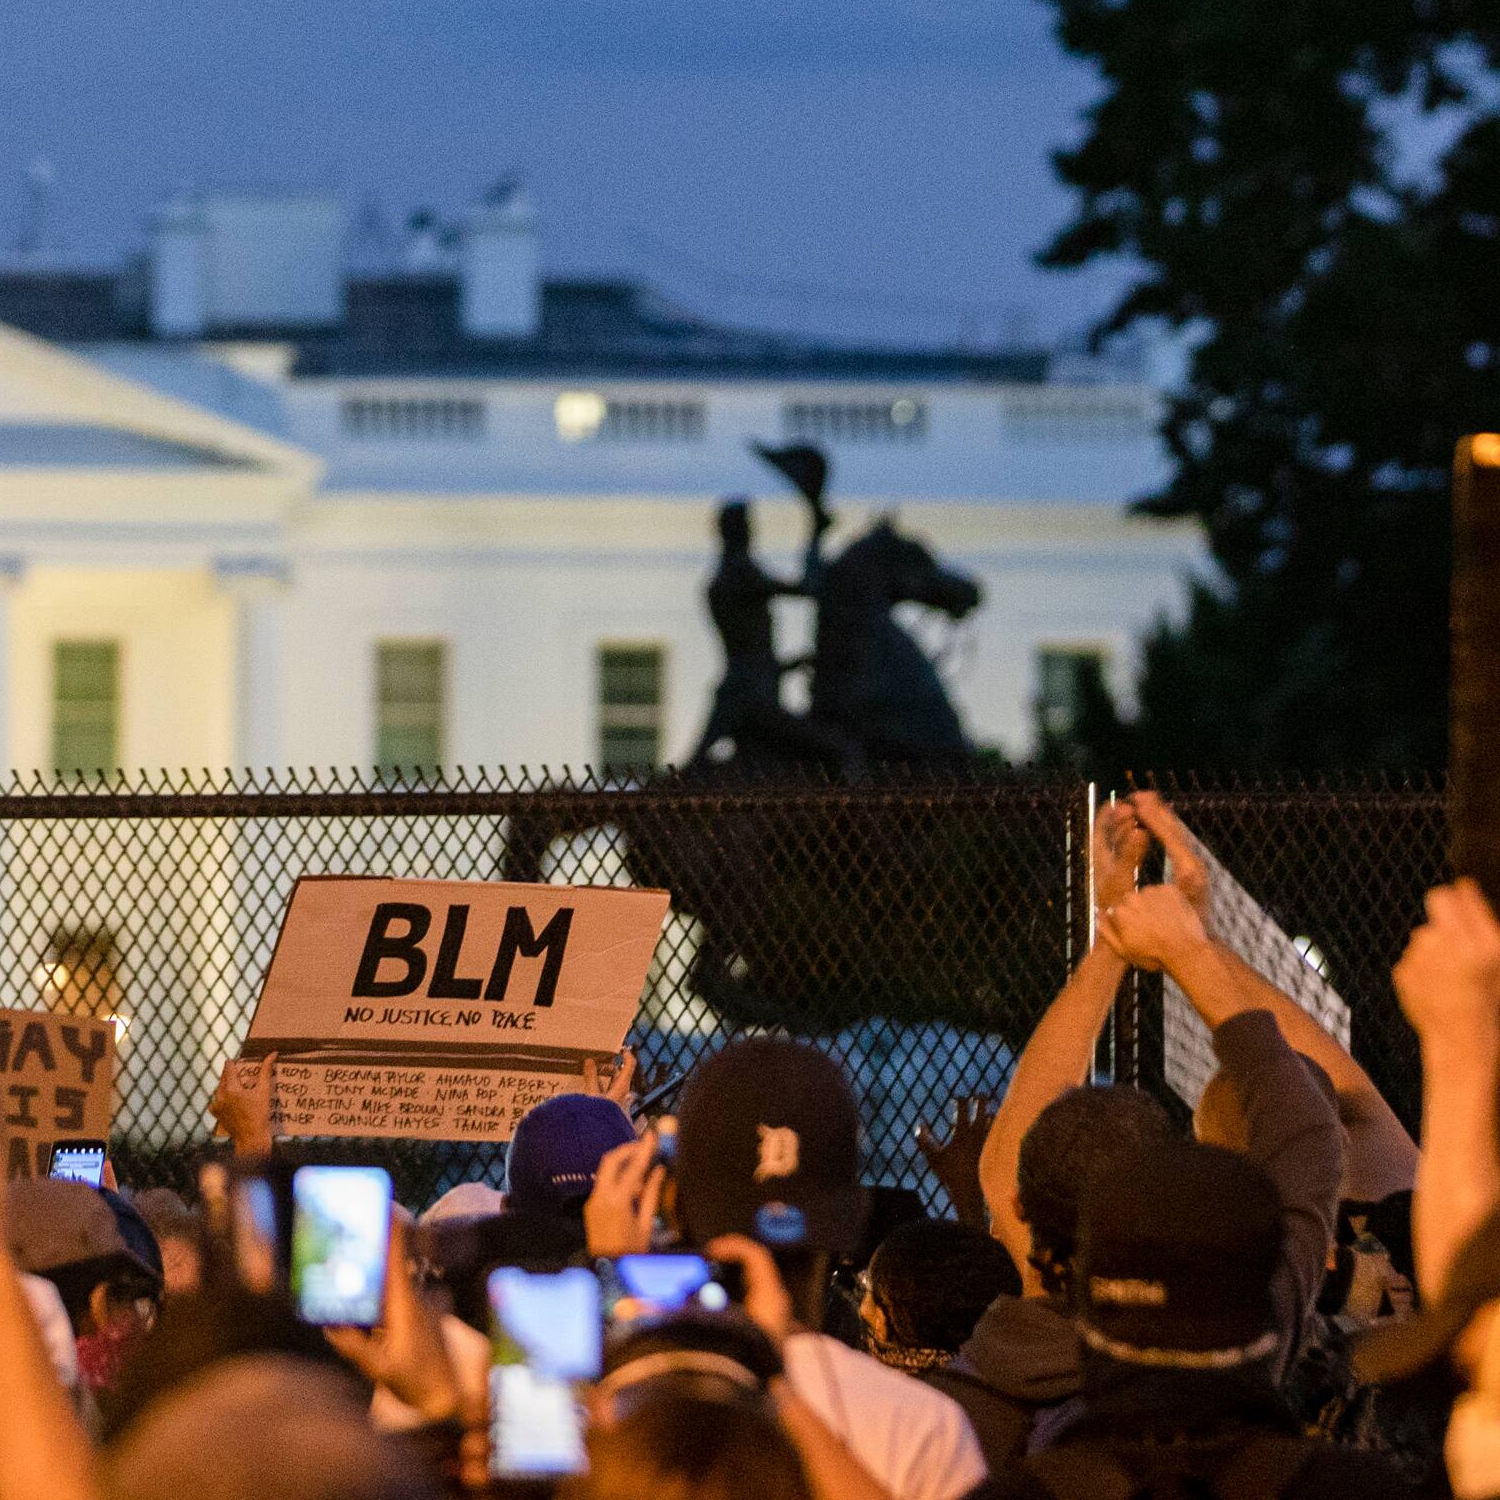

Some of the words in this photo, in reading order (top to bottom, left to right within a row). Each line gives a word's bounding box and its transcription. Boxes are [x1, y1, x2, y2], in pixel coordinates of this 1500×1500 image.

[351, 902, 575, 1007] BLM
[344, 1007, 374, 1023] NO
[455, 1009, 482, 1026] NO
[324, 1069, 382, 1083] BREONNA
[385, 1070, 425, 1084] TAYLOR
[436, 1074, 491, 1086] AHMAUD
[325, 1084, 365, 1096] TONY
[435, 1088, 469, 1101] NINA
[476, 1088, 497, 1100] POP
[295, 1098, 351, 1111] MARTIN
[362, 1099, 395, 1114] MIKE
[399, 1102, 445, 1116] BROWN
[456, 1104, 506, 1118] SANDRA
[394, 1116, 442, 1130] HAYES
[453, 1118, 500, 1132] TAMIR
